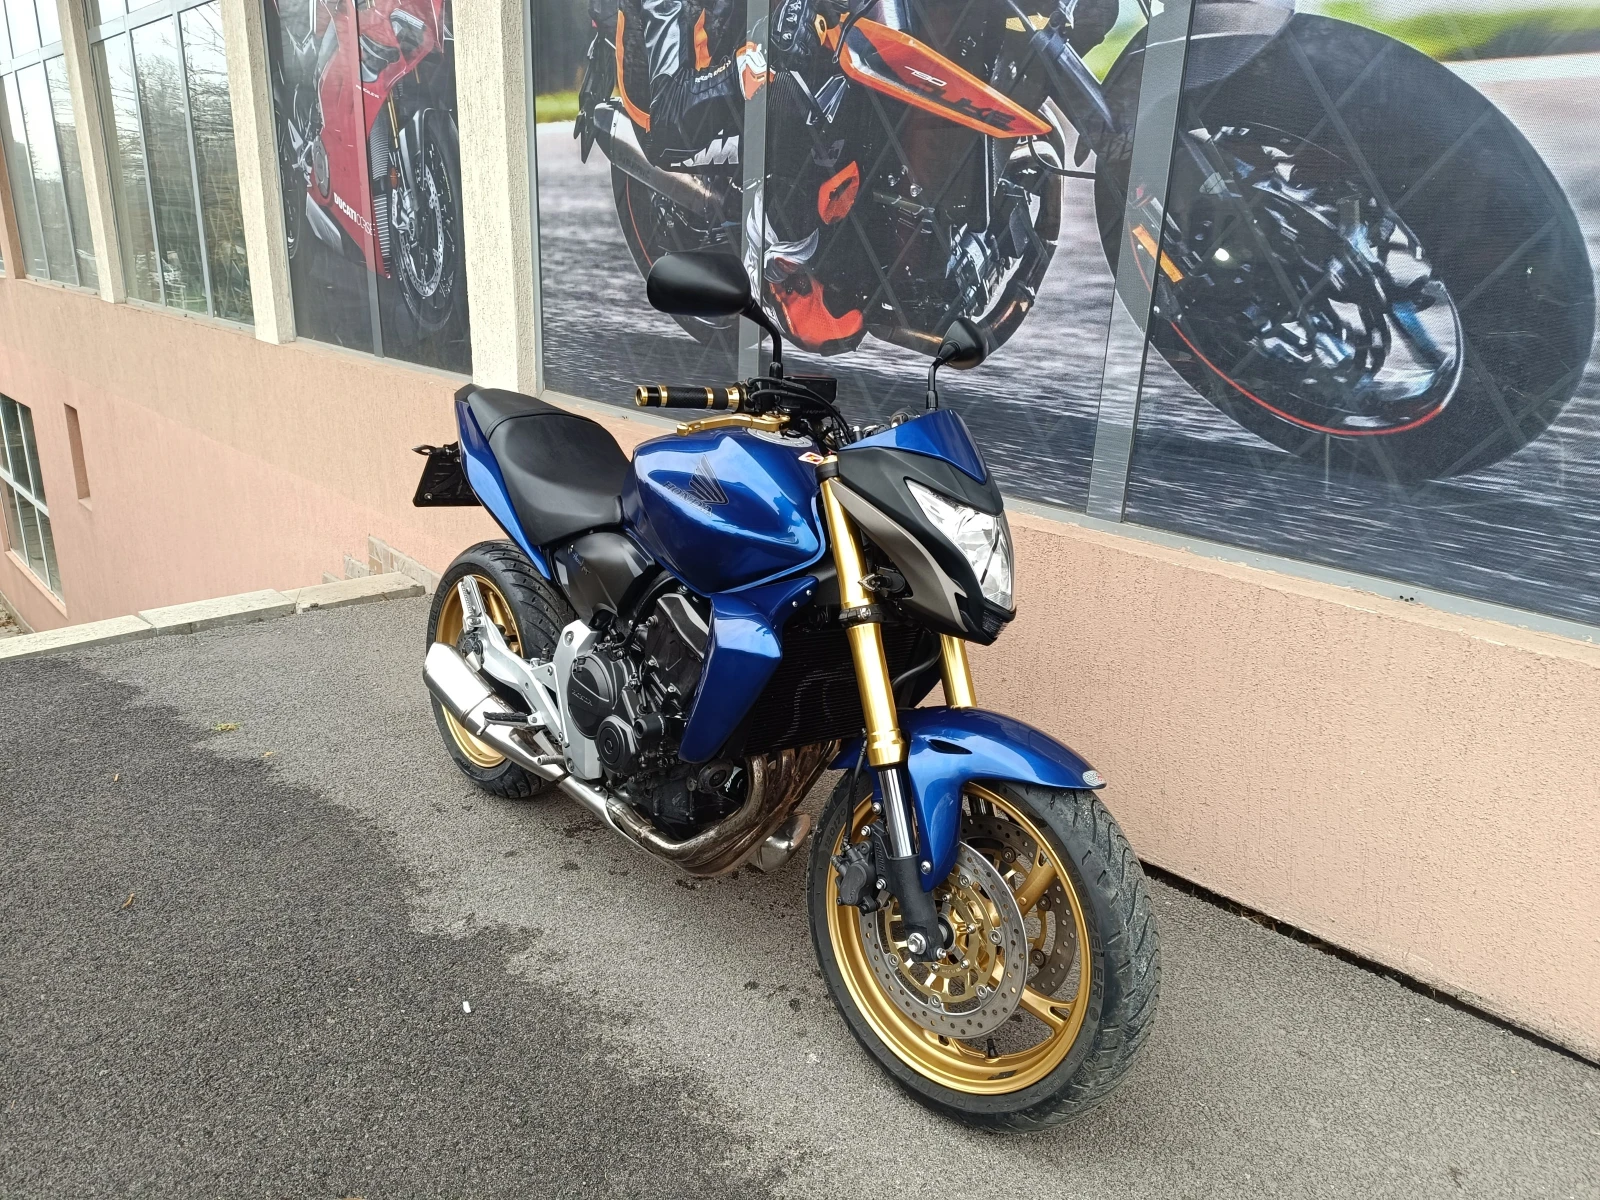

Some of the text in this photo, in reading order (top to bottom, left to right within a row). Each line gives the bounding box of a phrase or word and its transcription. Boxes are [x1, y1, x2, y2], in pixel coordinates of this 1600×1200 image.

[904, 65, 948, 87] 790
[663, 480, 713, 518] HONDA
[1067, 864, 1105, 1000] METZELER
[890, 1060, 967, 1108] ROADTEC
